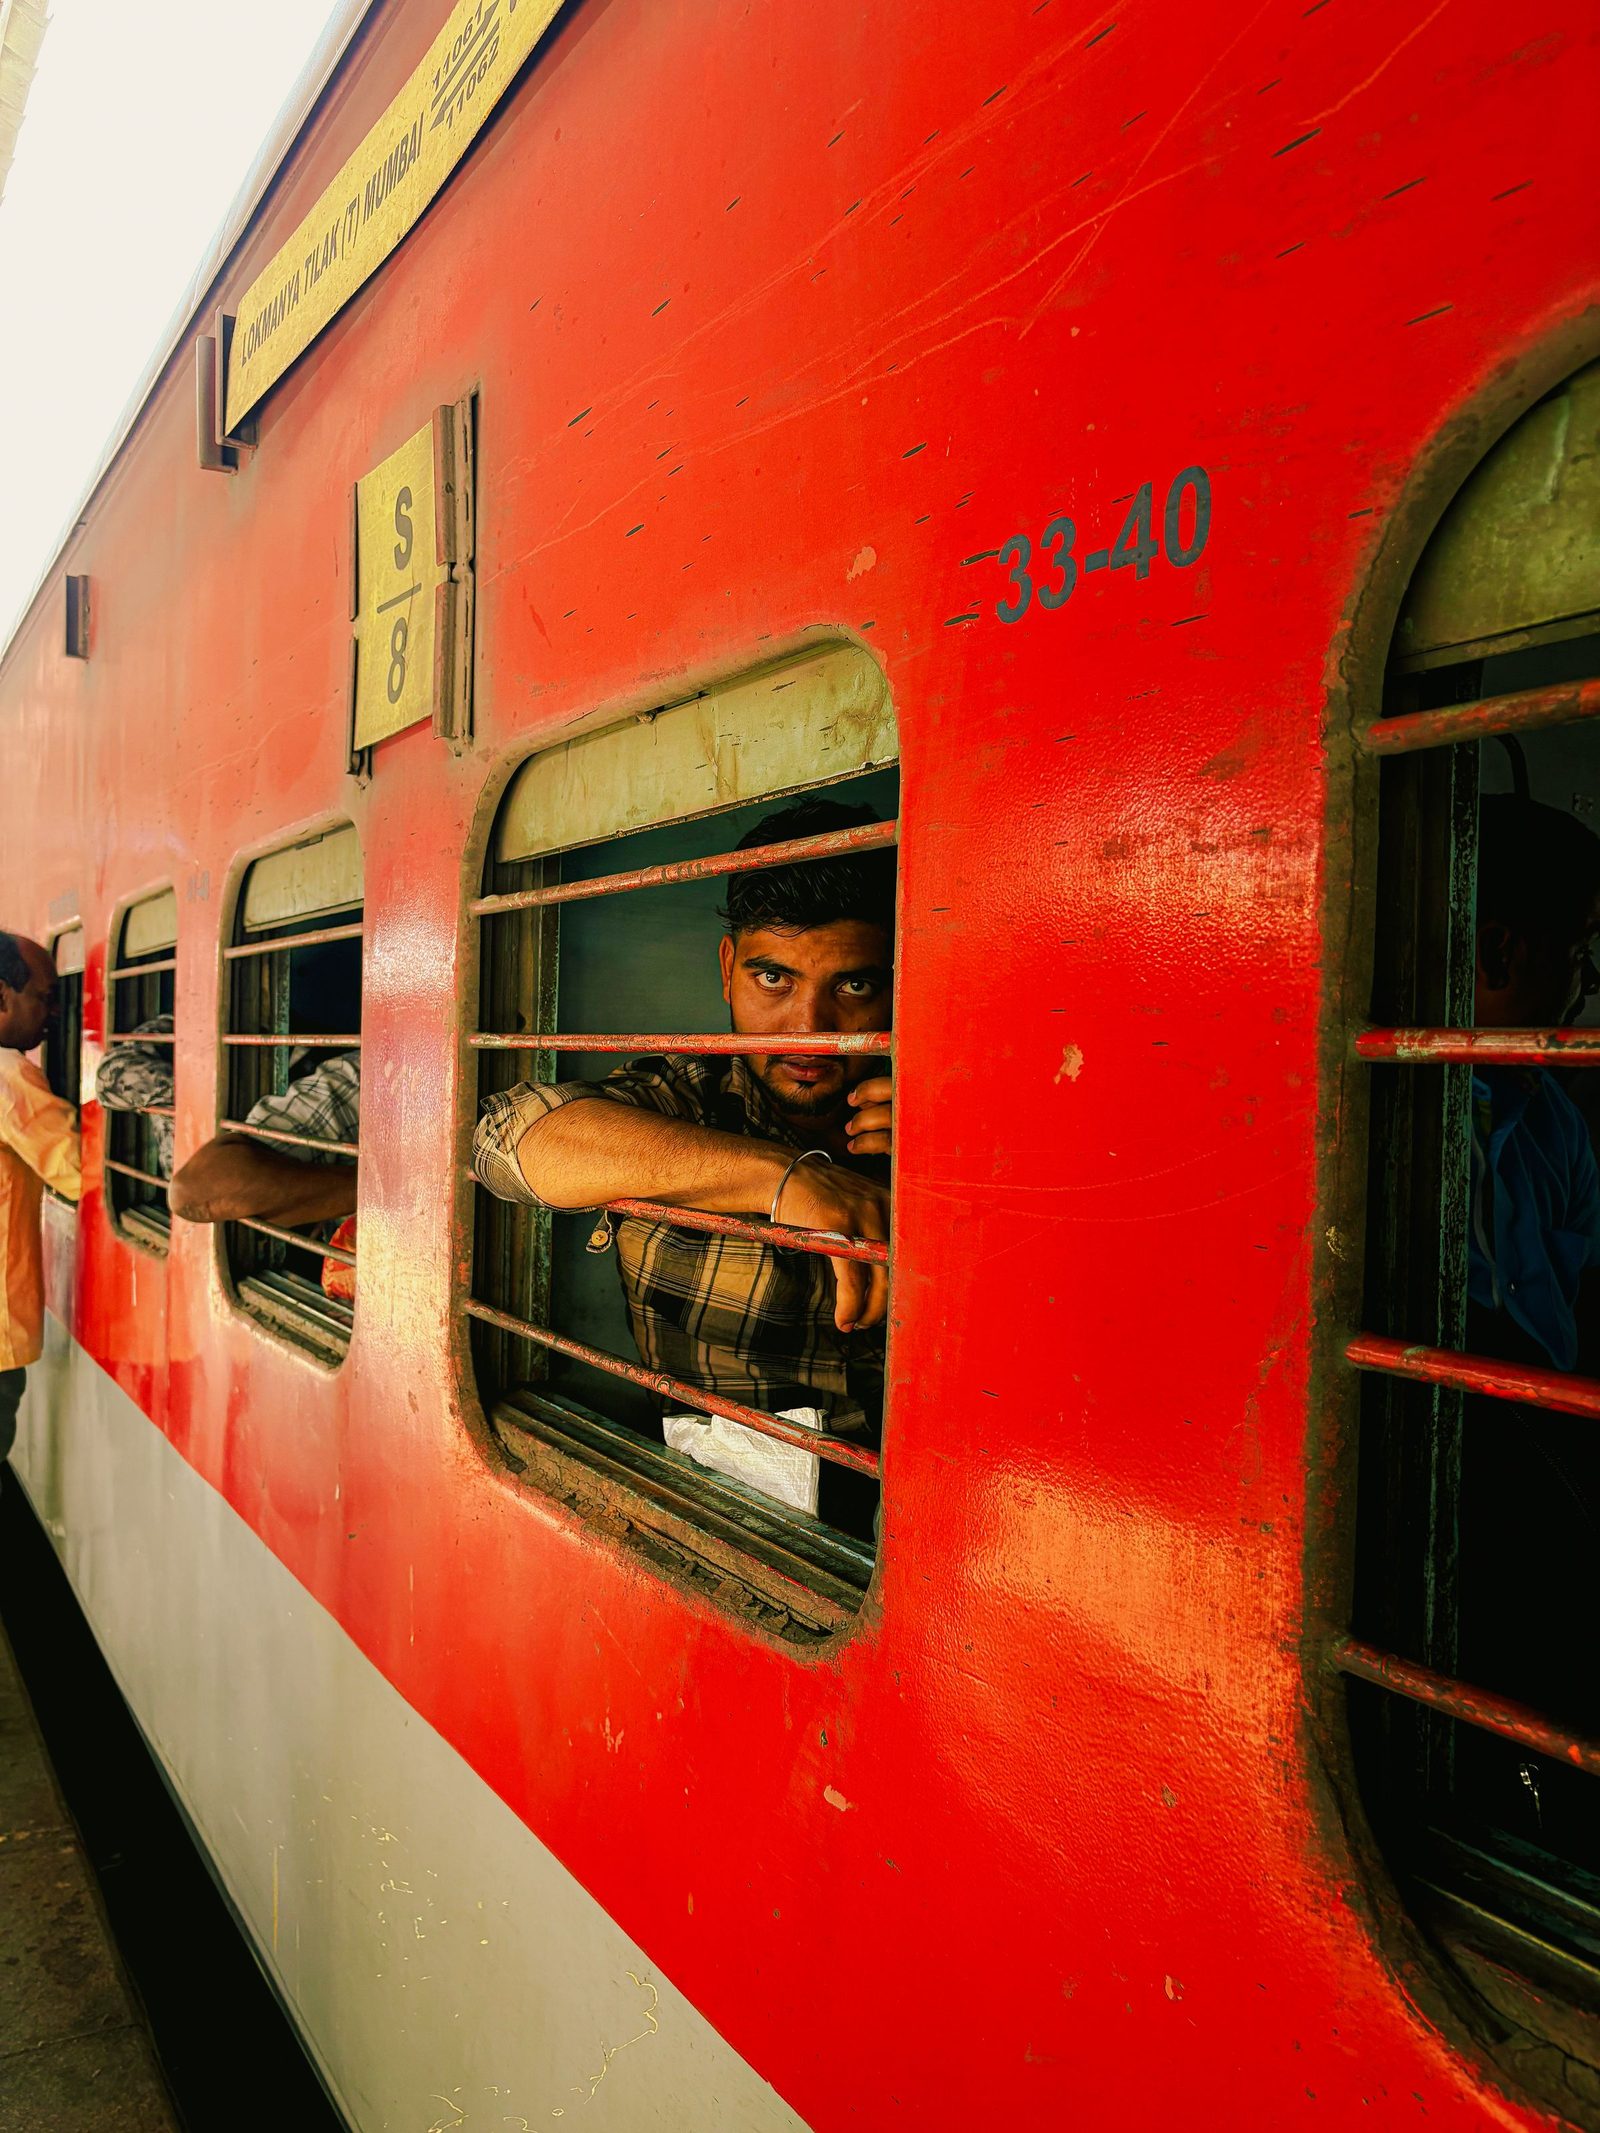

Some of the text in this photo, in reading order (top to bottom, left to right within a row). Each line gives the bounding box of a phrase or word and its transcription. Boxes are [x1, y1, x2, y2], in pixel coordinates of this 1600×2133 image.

[433, 0, 483, 92] 11061
[446, 35, 500, 129] 11062
[241, 110, 425, 368] LOKMANYA TILAK (T) MUMBAI
[394, 485, 413, 571] S
[996, 465, 1212, 624] 33-40
[387, 616, 408, 705] 8
